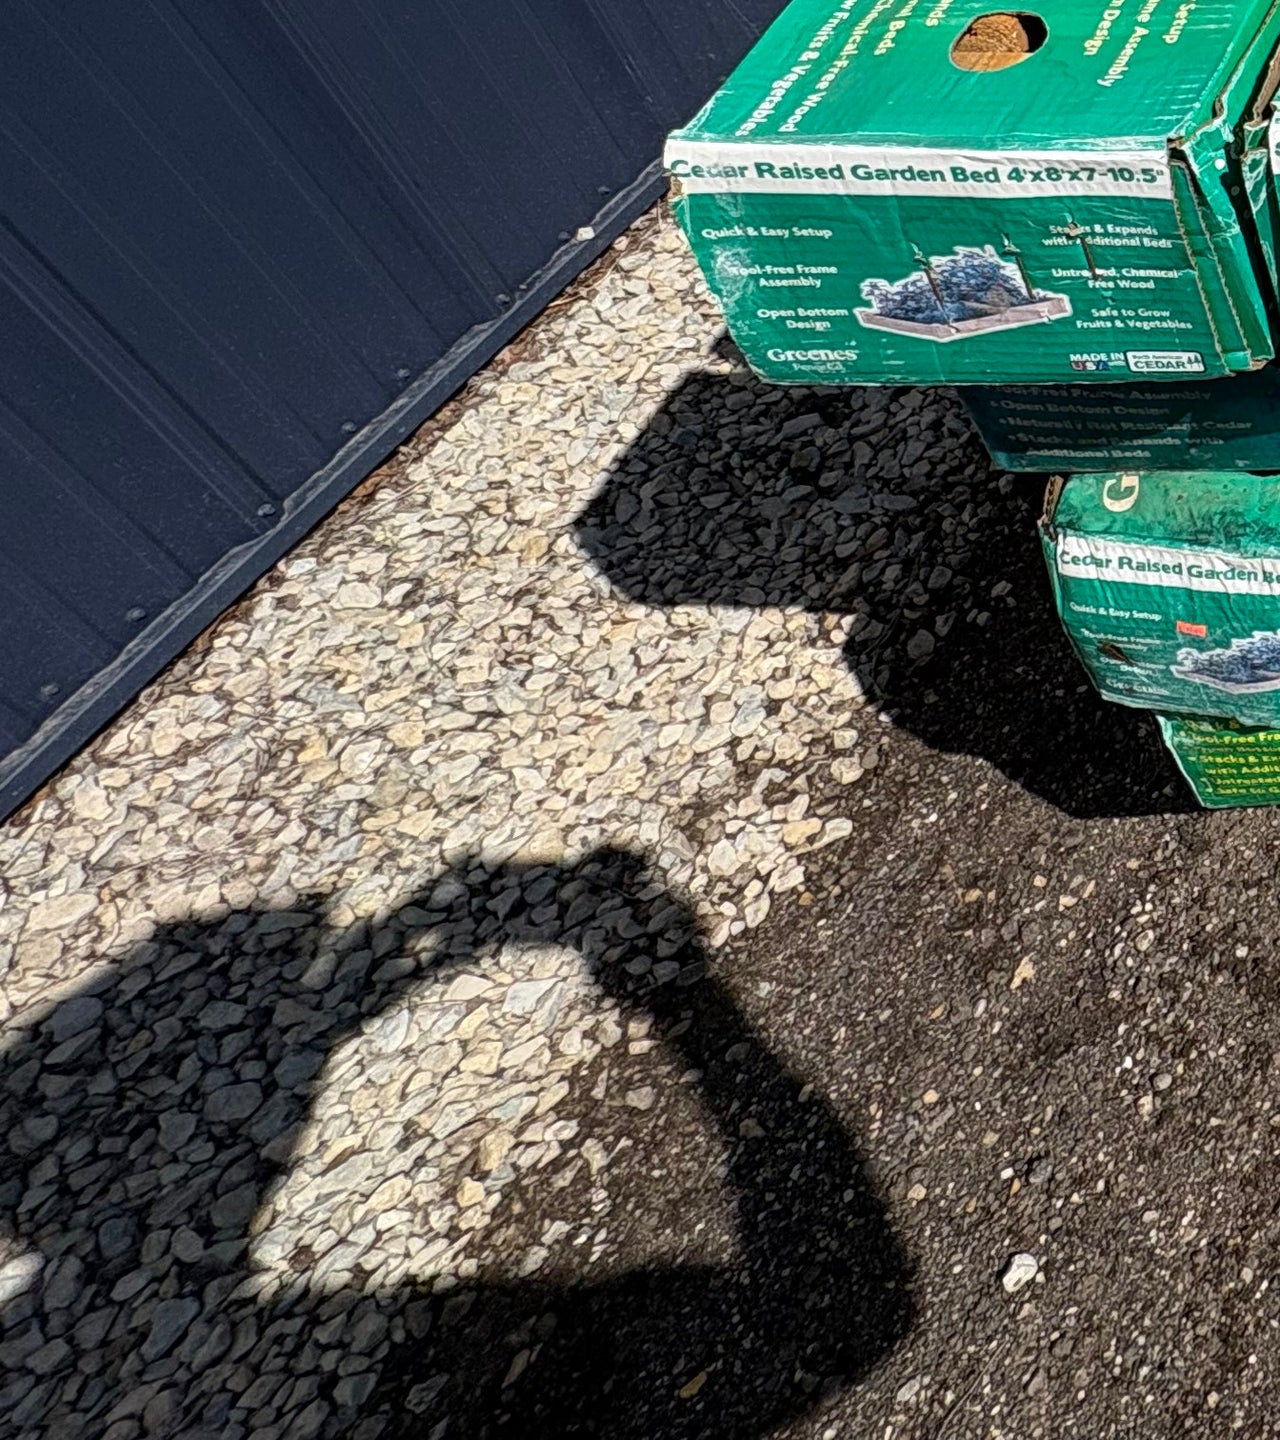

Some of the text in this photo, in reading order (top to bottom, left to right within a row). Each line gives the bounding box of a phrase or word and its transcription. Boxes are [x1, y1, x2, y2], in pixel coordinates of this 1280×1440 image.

[808, 11, 849, 49] Fruits
[1083, 9, 1121, 56] Design
[1162, 3, 1197, 45] Setup
[873, 20, 906, 56] Beds
[798, 51, 821, 62] &
[1096, 26, 1150, 88] Assembly
[734, 63, 812, 137] Vegetables
[777, 91, 828, 133] Wood
[670, 158, 749, 179] Cedar
[754, 161, 845, 181] Raised
[850, 163, 947, 182] Garden
[950, 166, 1001, 183] Bed
[701, 226, 833, 239] Quick & Easy Setup
[796, 263, 838, 275] Frame
[759, 277, 822, 289] Assembly
[757, 307, 849, 321] Open Bottom
[786, 319, 832, 331] Design
[767, 348, 858, 362] Greenes
[1070, 352, 1125, 362] MADE IN
[1134, 360, 1186, 370] CEDAR
[1058, 551, 1113, 569] Cedar
[1118, 556, 1183, 575] Raised
[1187, 563, 1259, 582] Garden
